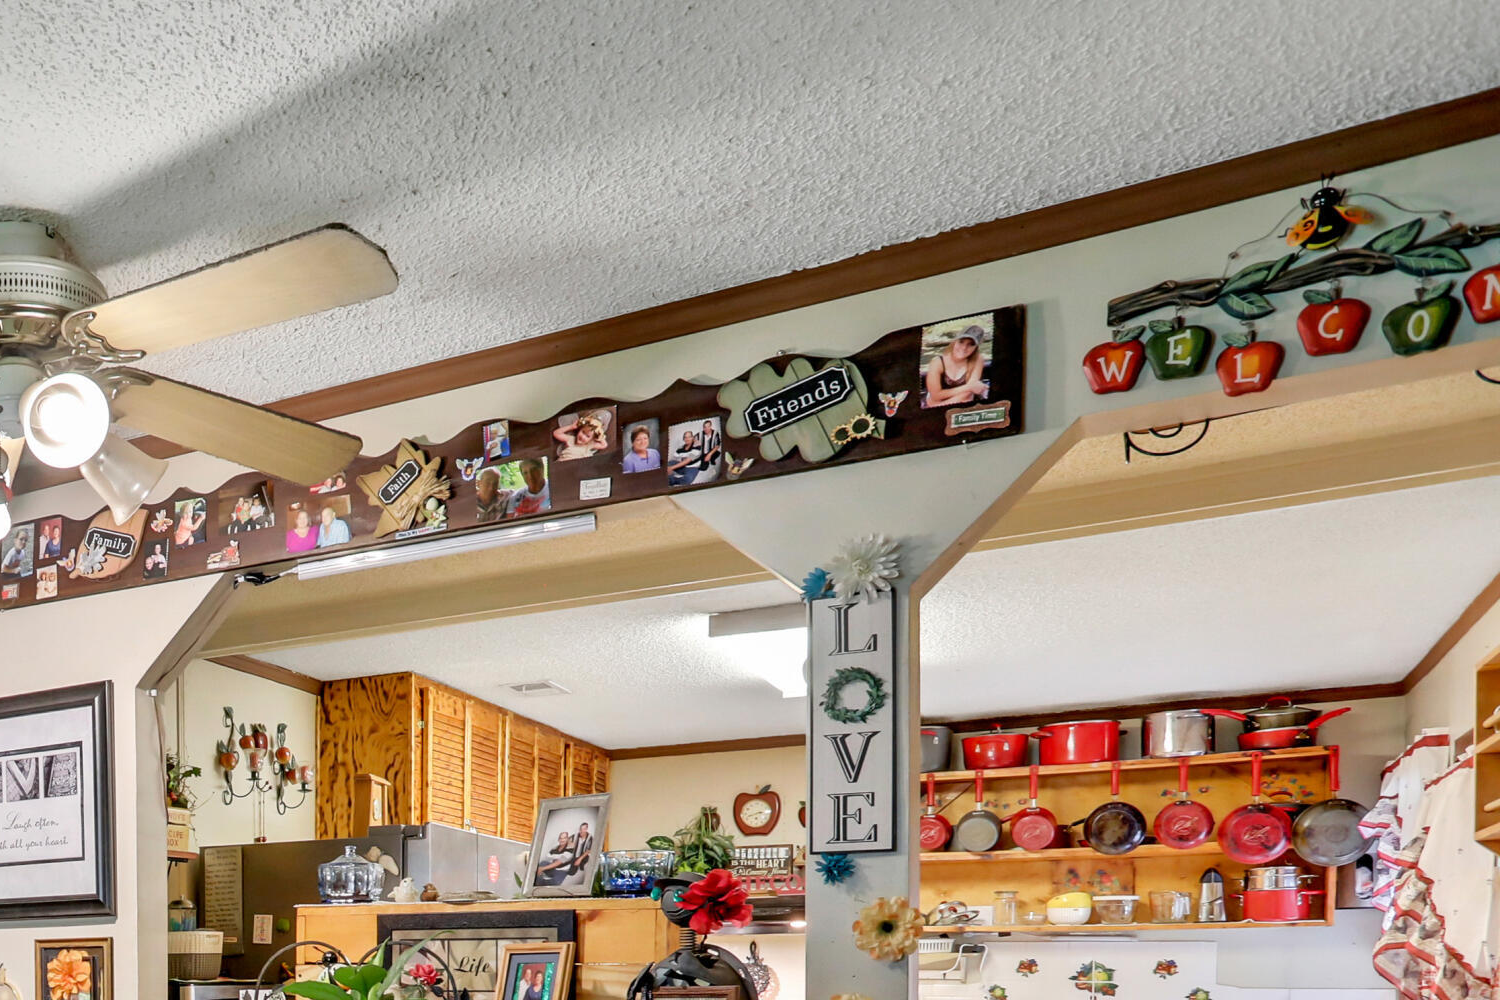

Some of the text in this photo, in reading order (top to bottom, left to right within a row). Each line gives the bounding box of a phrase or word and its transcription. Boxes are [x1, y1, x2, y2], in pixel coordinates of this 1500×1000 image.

[754, 380, 841, 427] Friends
[387, 472, 411, 495] Faith
[92, 532, 128, 553] Family
[2, 811, 33, 833] Laugh
[10, 838, 23, 850] all
[25, 840, 43, 851] your
[756, 858, 786, 869] HEART
[454, 955, 490, 976] Life
